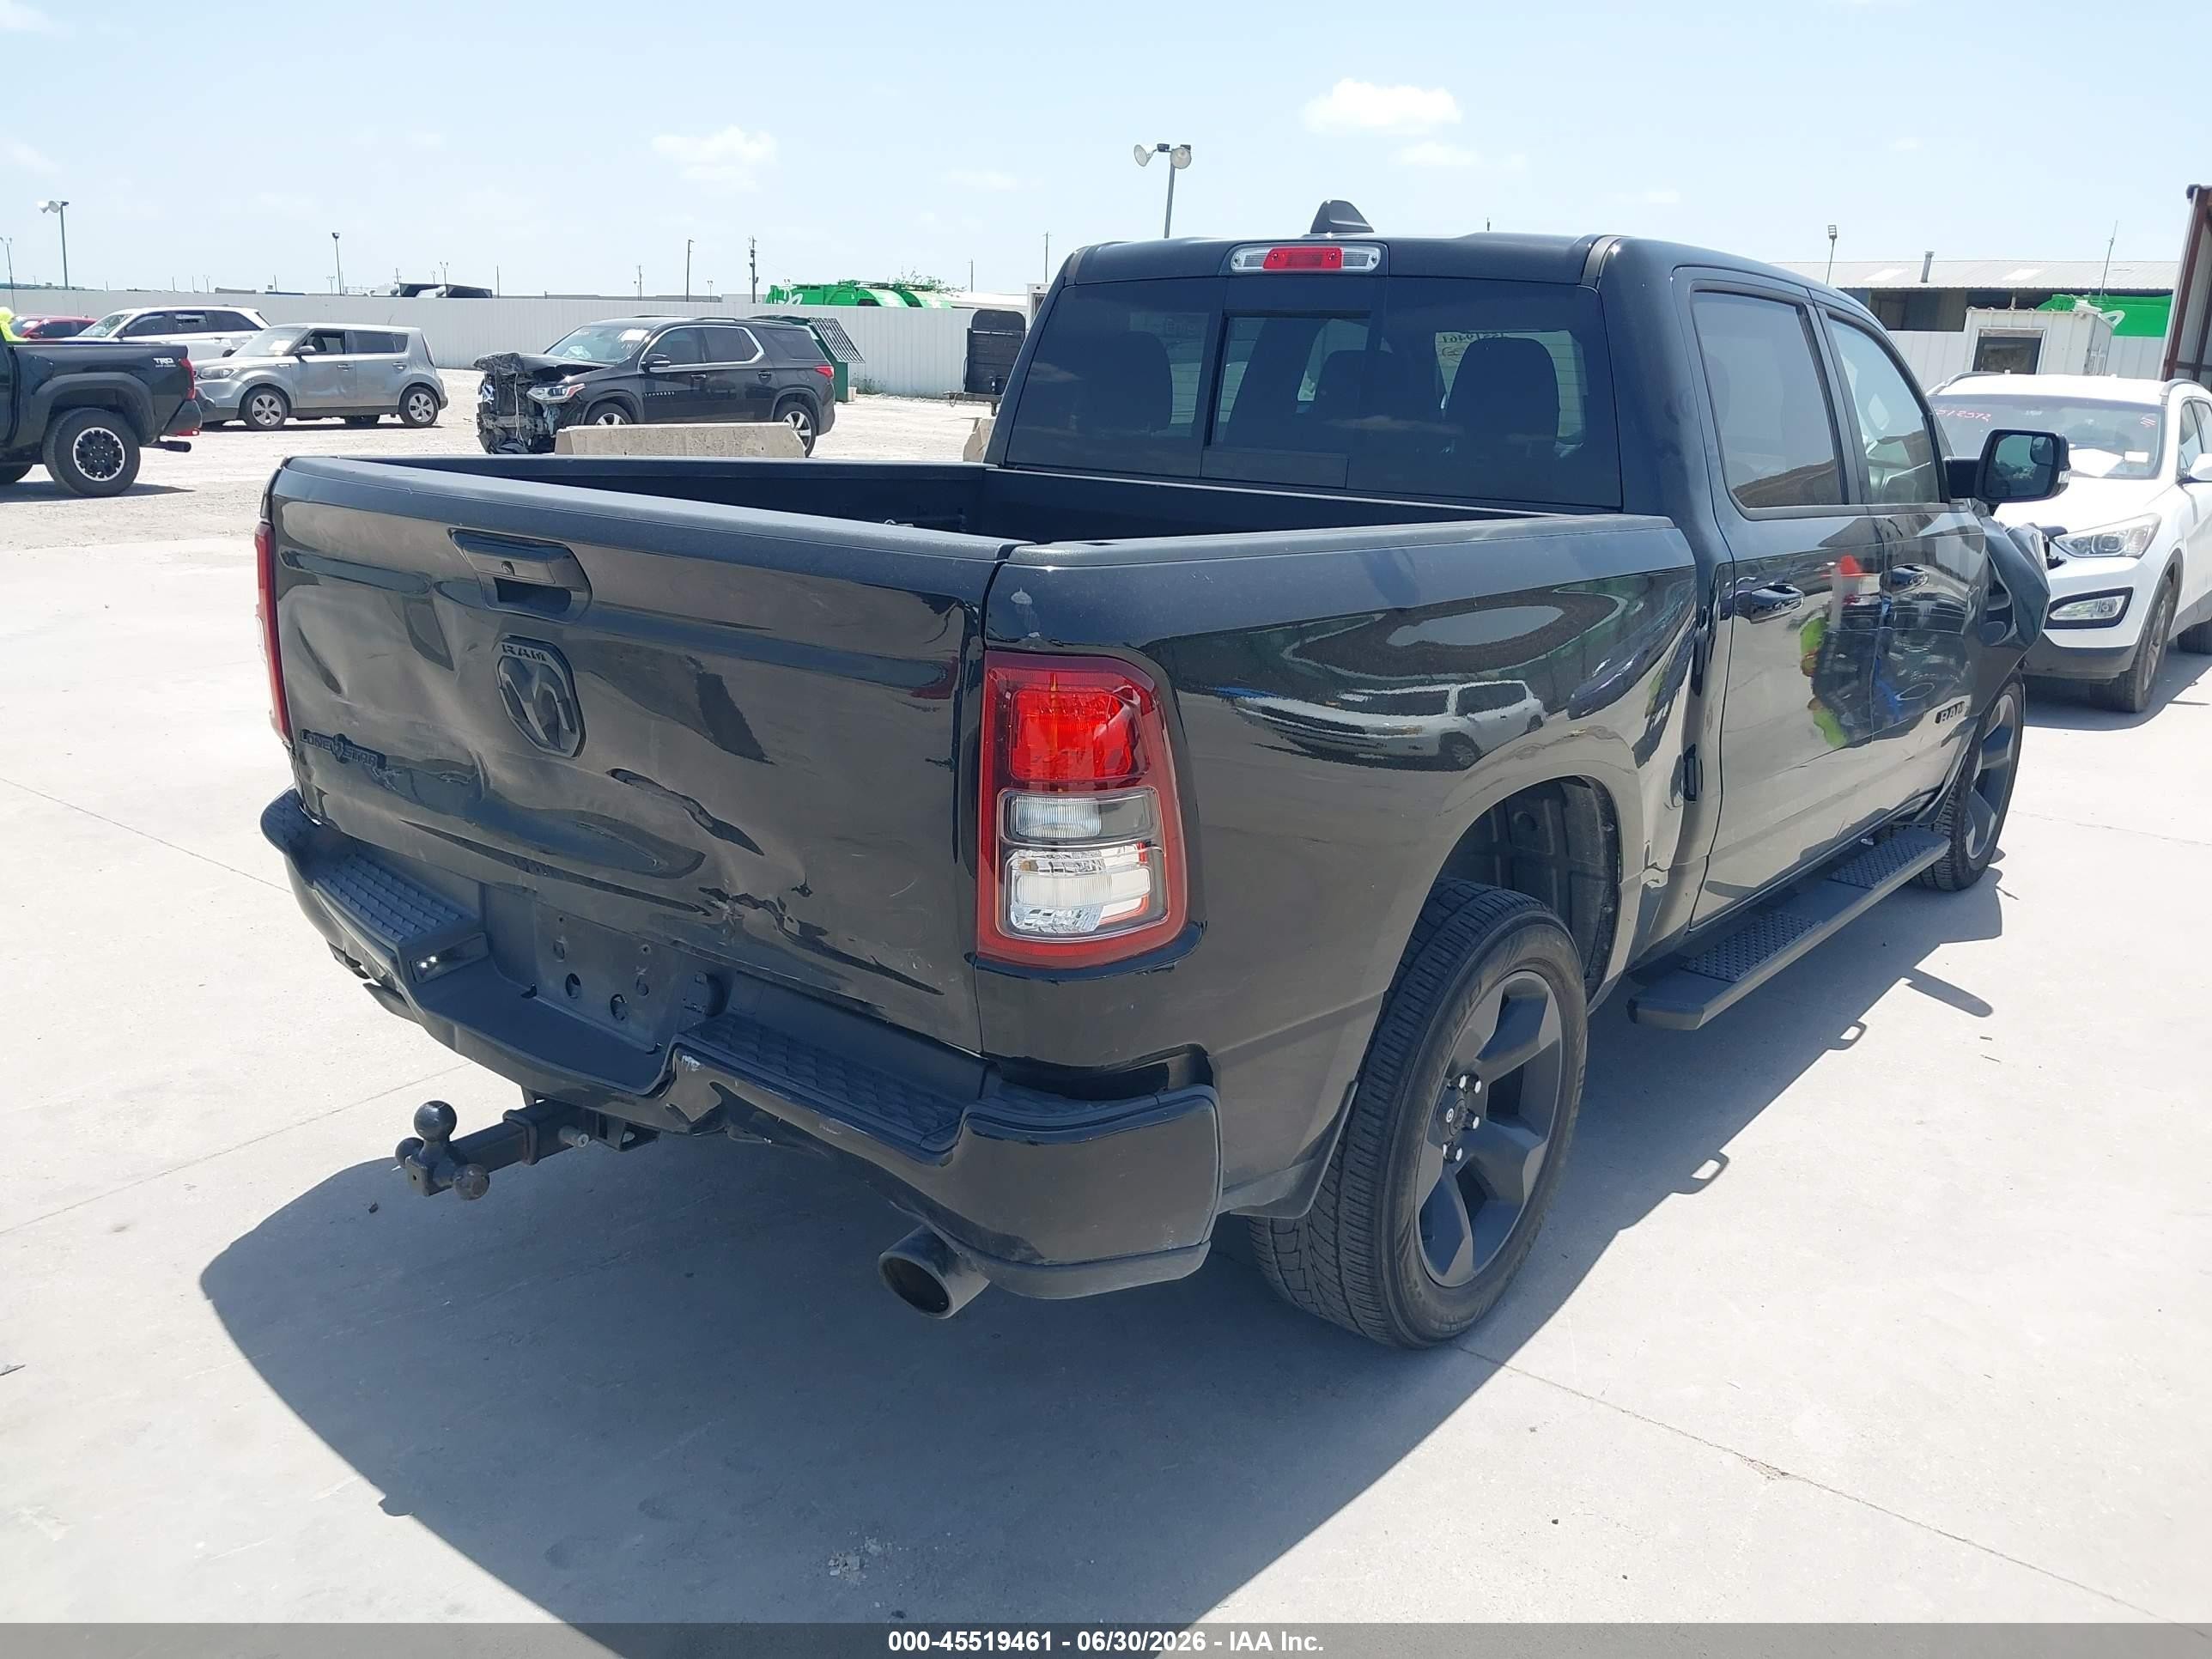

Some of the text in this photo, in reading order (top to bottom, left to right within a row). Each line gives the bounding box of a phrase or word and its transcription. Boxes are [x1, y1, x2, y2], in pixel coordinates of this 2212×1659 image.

[501, 643, 547, 661] RAM
[300, 729, 379, 769] LONE STAR
